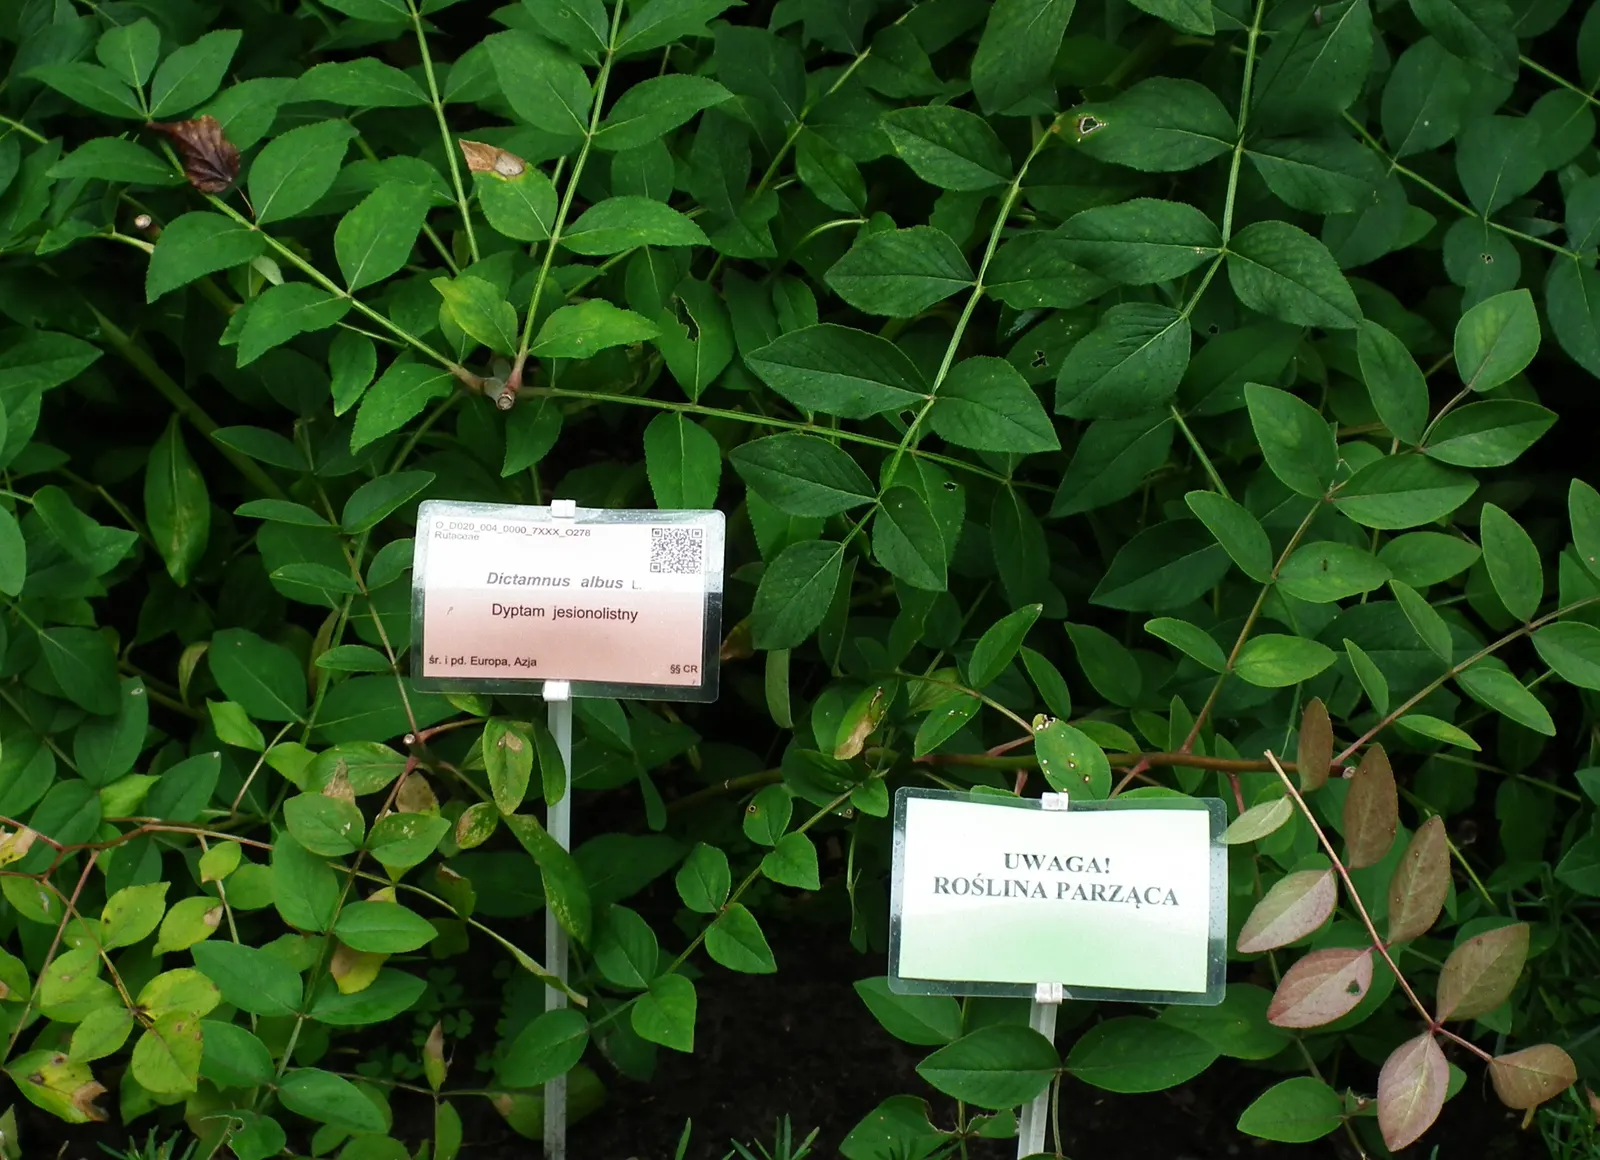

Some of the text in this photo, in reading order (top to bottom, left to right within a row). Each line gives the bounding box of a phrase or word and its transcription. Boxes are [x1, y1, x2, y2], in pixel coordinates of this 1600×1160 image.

[434, 532, 480, 541] Rutaceae
[487, 572, 571, 587] Dictamnus
[581, 576, 624, 589] albus
[492, 603, 638, 623] Dyptam jesionolistny
[429, 654, 442, 665] śr.
[451, 656, 467, 667] pd.
[470, 656, 511, 668] Europa,
[514, 657, 537, 668] Azja
[683, 665, 698, 674] CR
[1004, 853, 1111, 874] UWAGA!
[933, 873, 1180, 909] ROŚLINA PARZĄCA
